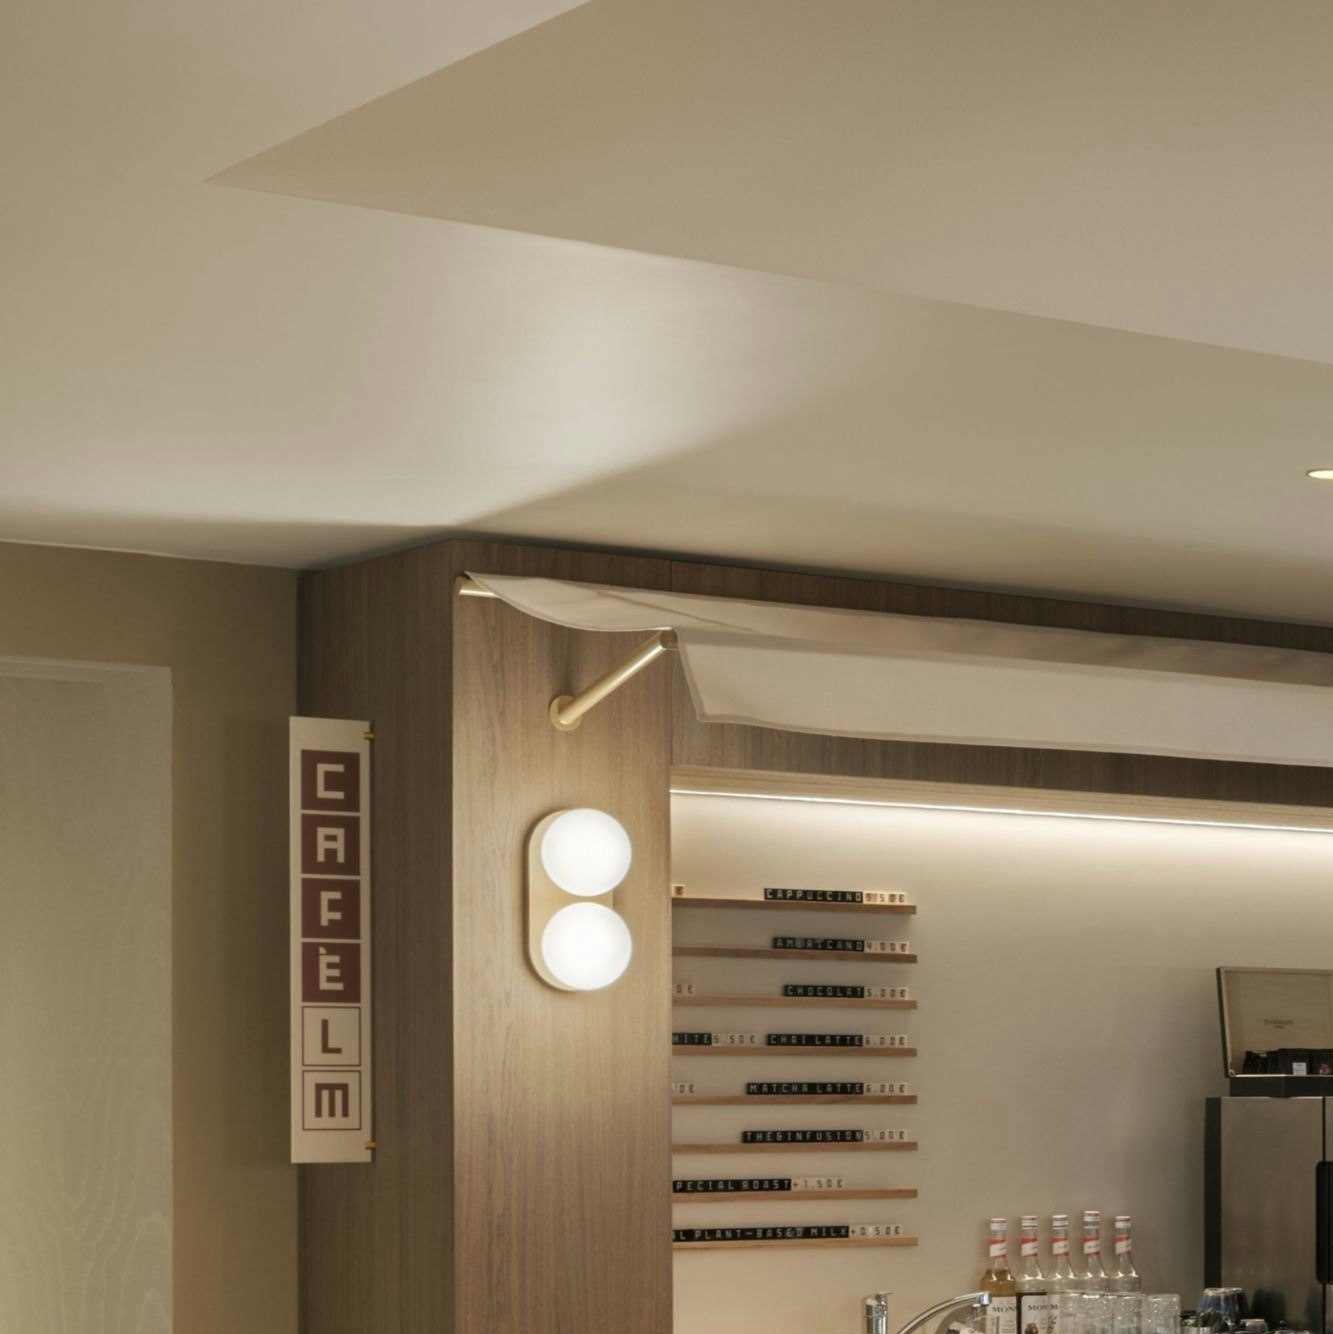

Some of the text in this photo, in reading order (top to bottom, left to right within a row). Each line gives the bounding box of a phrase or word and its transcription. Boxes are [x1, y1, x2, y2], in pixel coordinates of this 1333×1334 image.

[766, 889, 862, 902] CAPPUCCINO
[787, 985, 862, 997] CHOCOLAT
[672, 1034, 710, 1044] HITE
[770, 1035, 806, 1045] CHAI
[815, 1035, 862, 1046] LATTE
[750, 1083, 808, 1094] MATCHA
[816, 1084, 862, 1094] LATTE
[676, 1181, 735, 1192] PECIAL
[742, 1179, 790, 1191] ROAST
[811, 1226, 848, 1238] MILK
